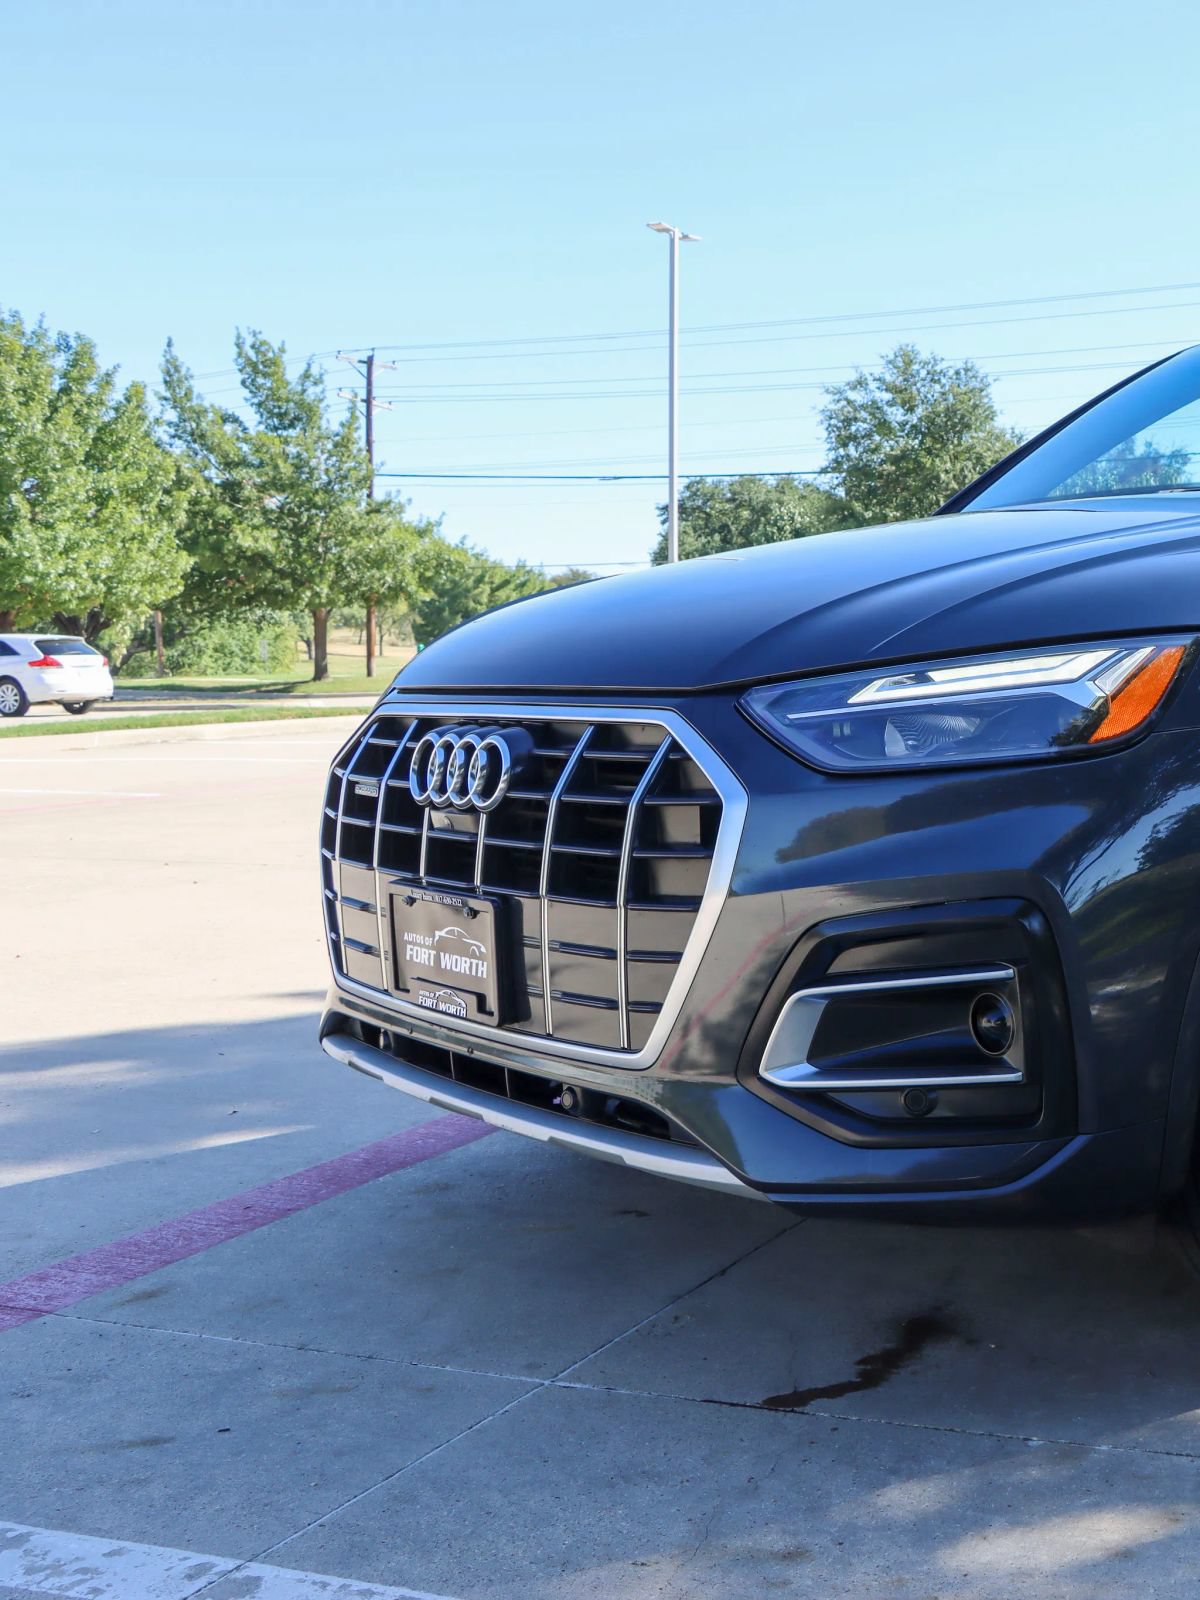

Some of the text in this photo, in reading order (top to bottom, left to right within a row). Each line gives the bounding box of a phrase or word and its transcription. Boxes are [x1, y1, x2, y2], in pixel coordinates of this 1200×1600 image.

[404, 932, 433, 947] AUTOS OF
[406, 944, 487, 979] FORT WORTH
[419, 996, 466, 1018] FORT WORTH
